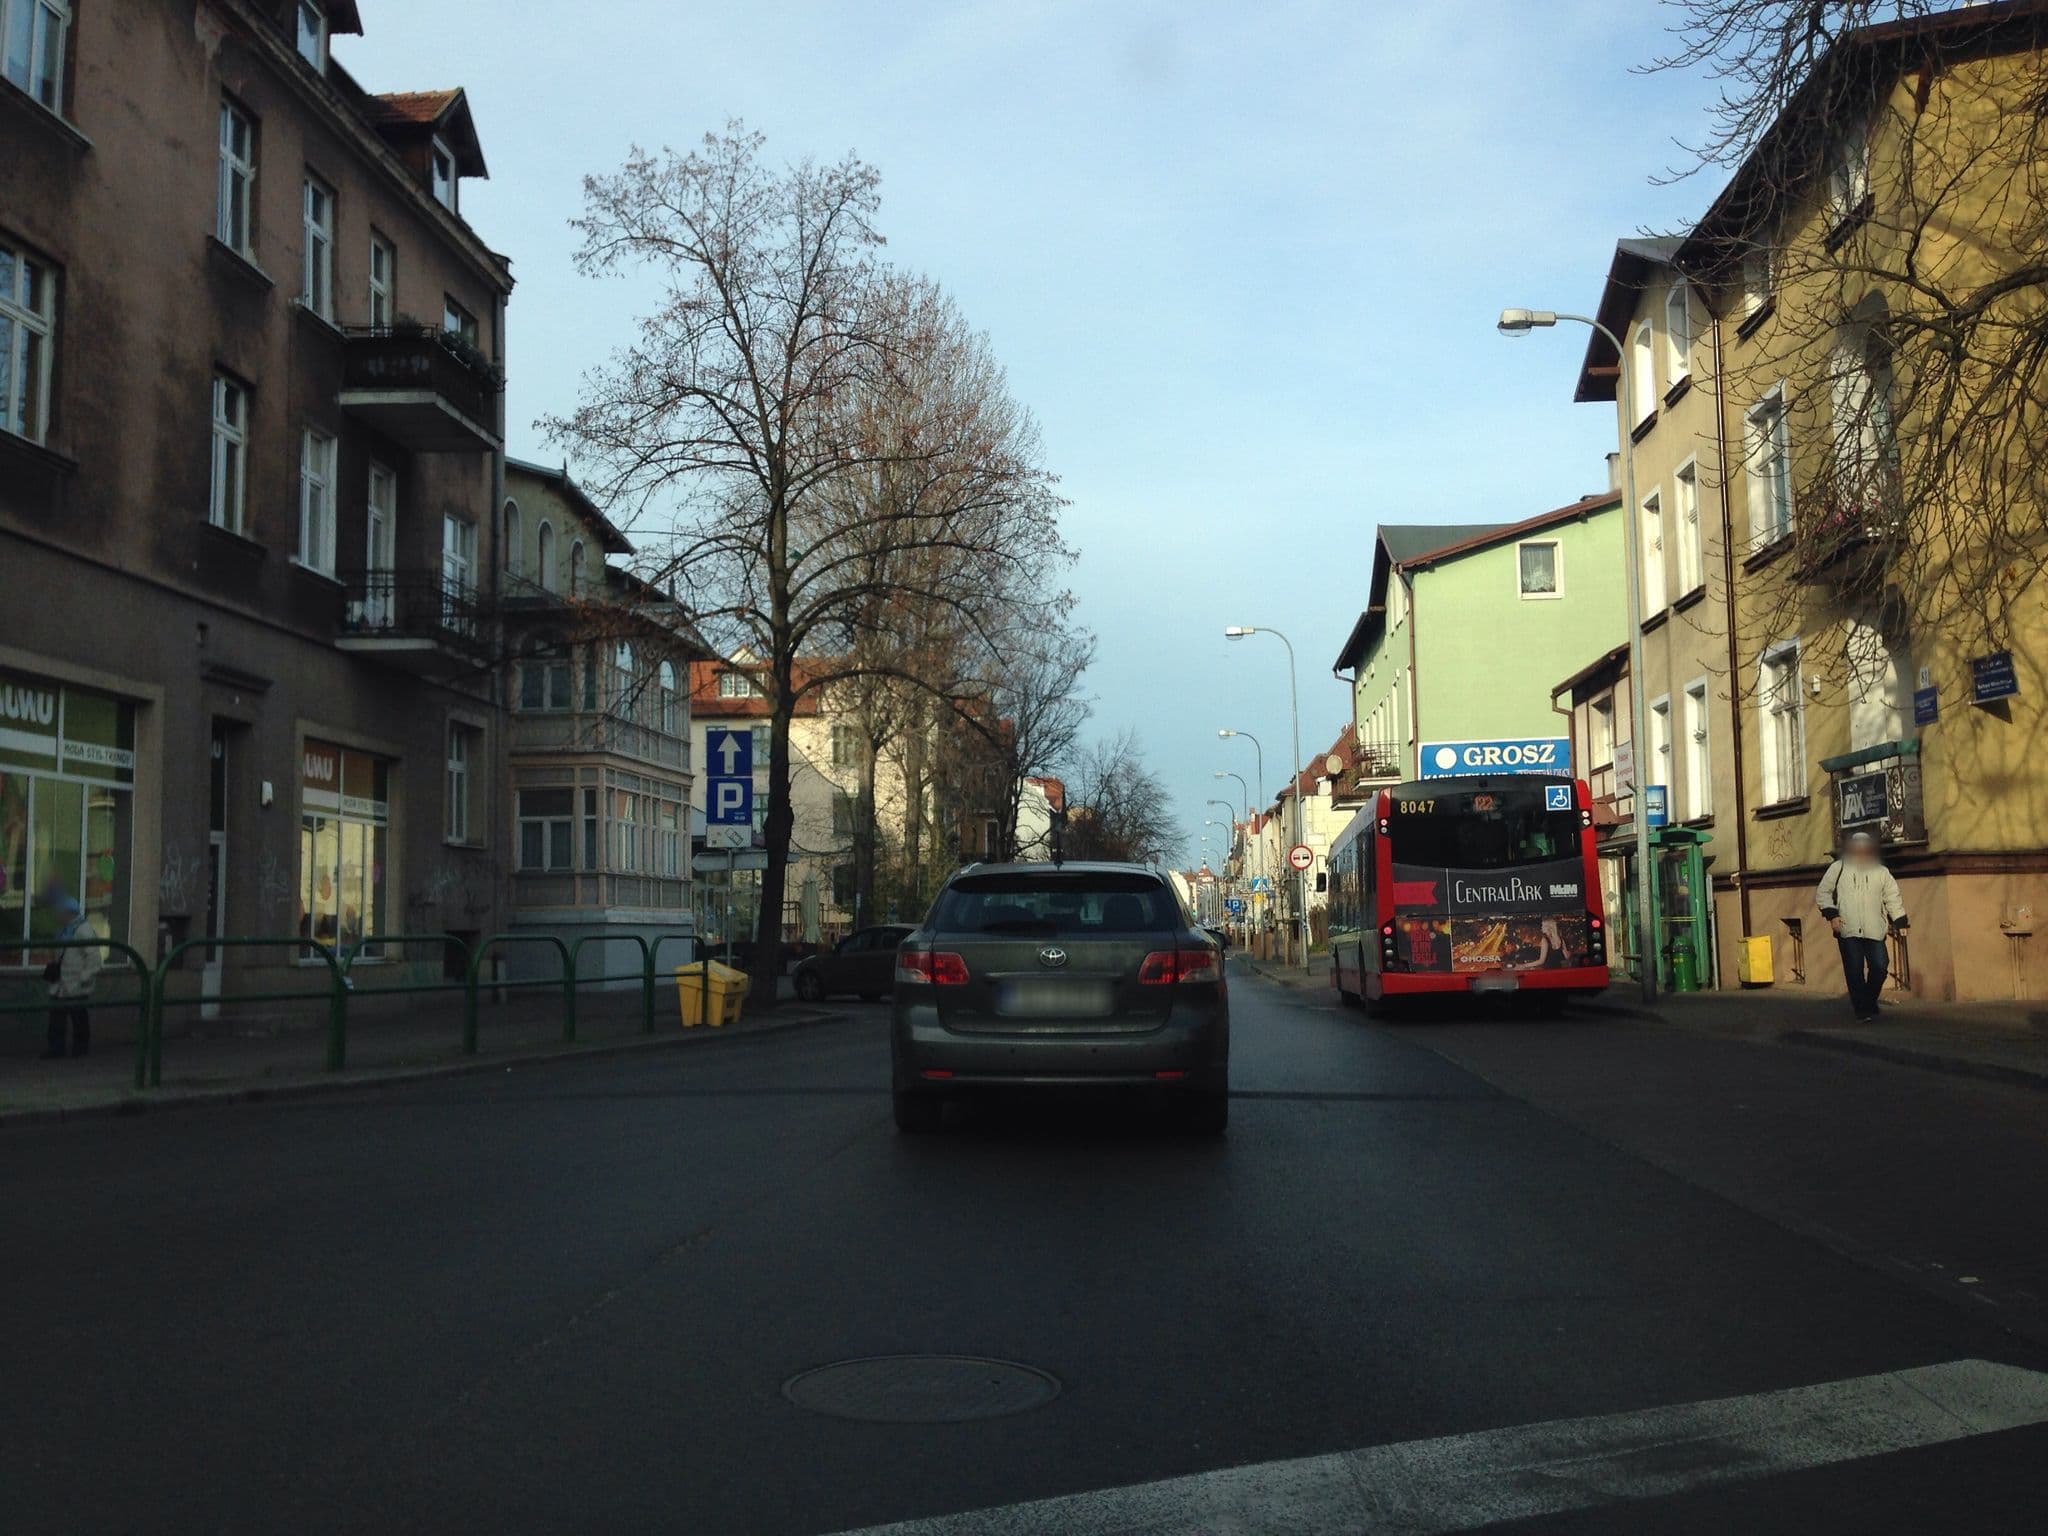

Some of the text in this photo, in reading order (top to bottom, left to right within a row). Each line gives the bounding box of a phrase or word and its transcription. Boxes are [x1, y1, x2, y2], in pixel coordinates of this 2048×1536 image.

[1463, 744, 1556, 766] GROSZ
[717, 782, 743, 819] P
[1400, 800, 1434, 814] 8047
